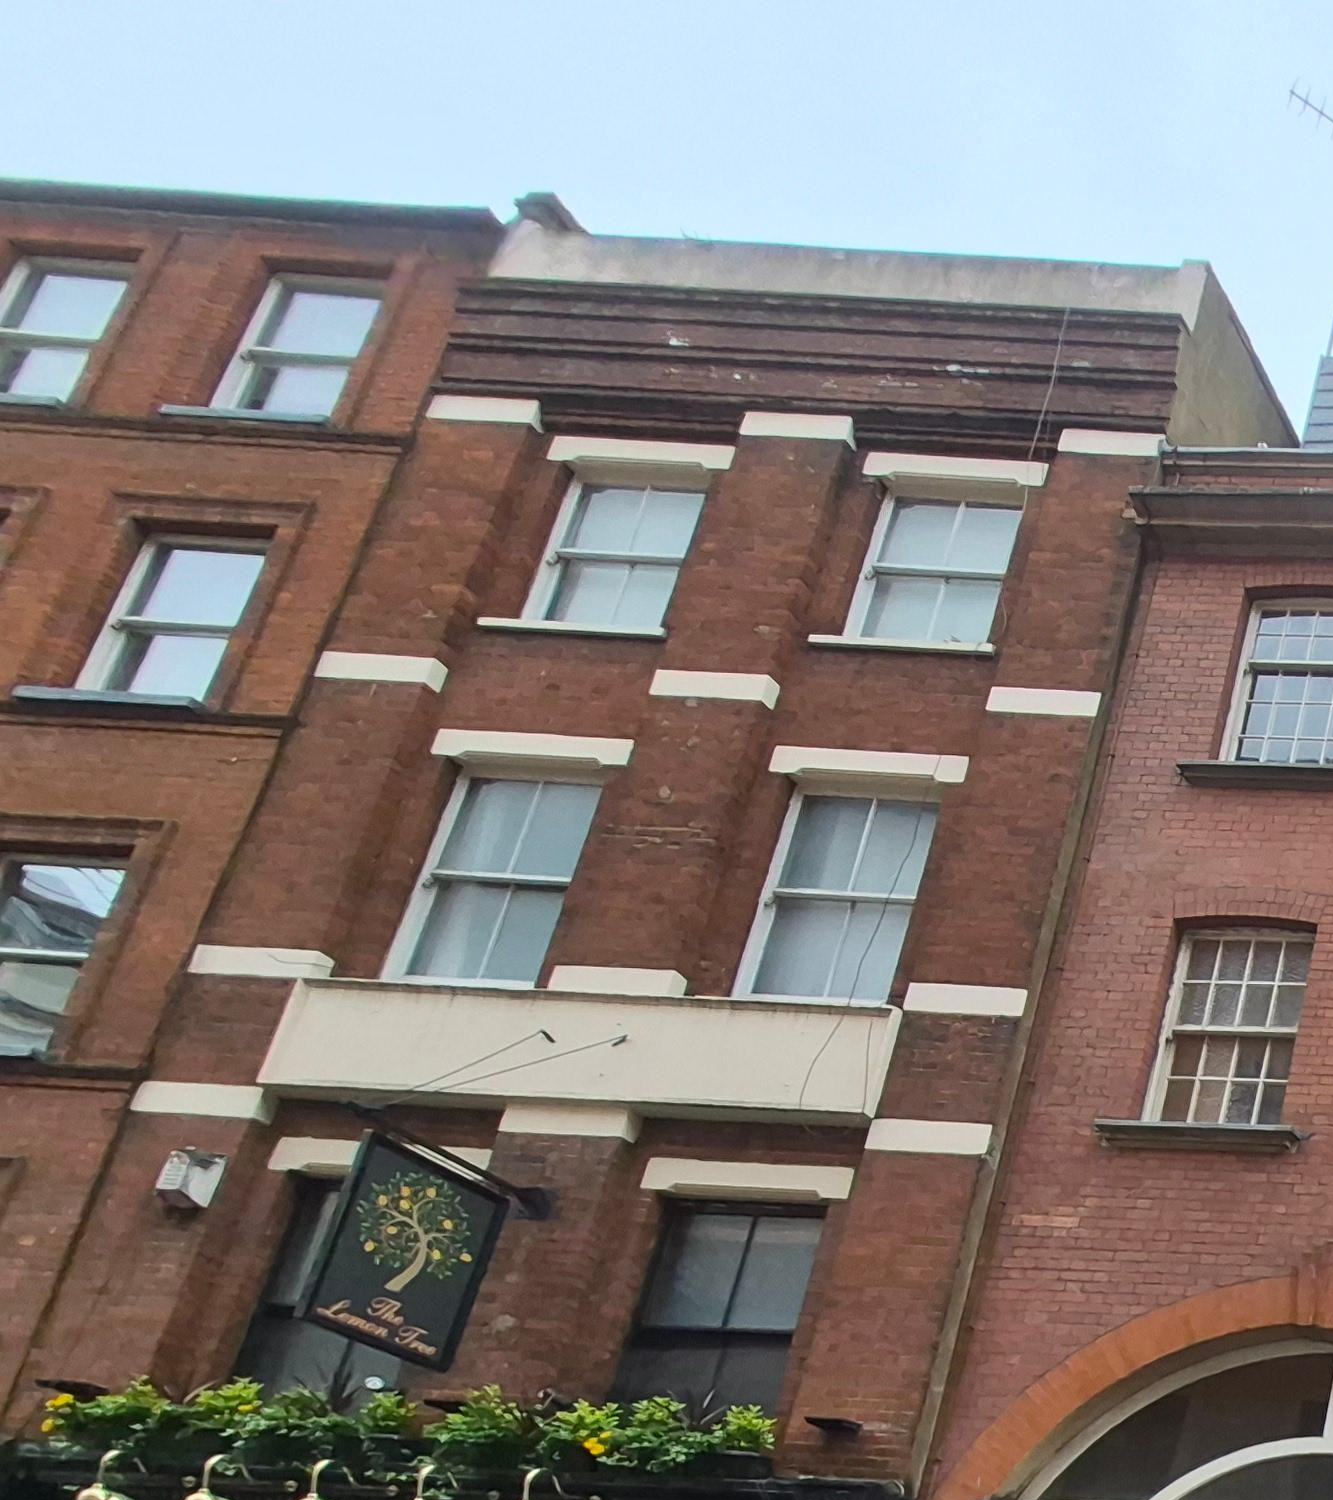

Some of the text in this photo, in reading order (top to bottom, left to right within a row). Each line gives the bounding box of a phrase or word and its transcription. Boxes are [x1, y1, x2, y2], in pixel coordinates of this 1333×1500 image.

[316, 1299, 438, 1356] Lemon Tree
[366, 1296, 404, 1325] The
